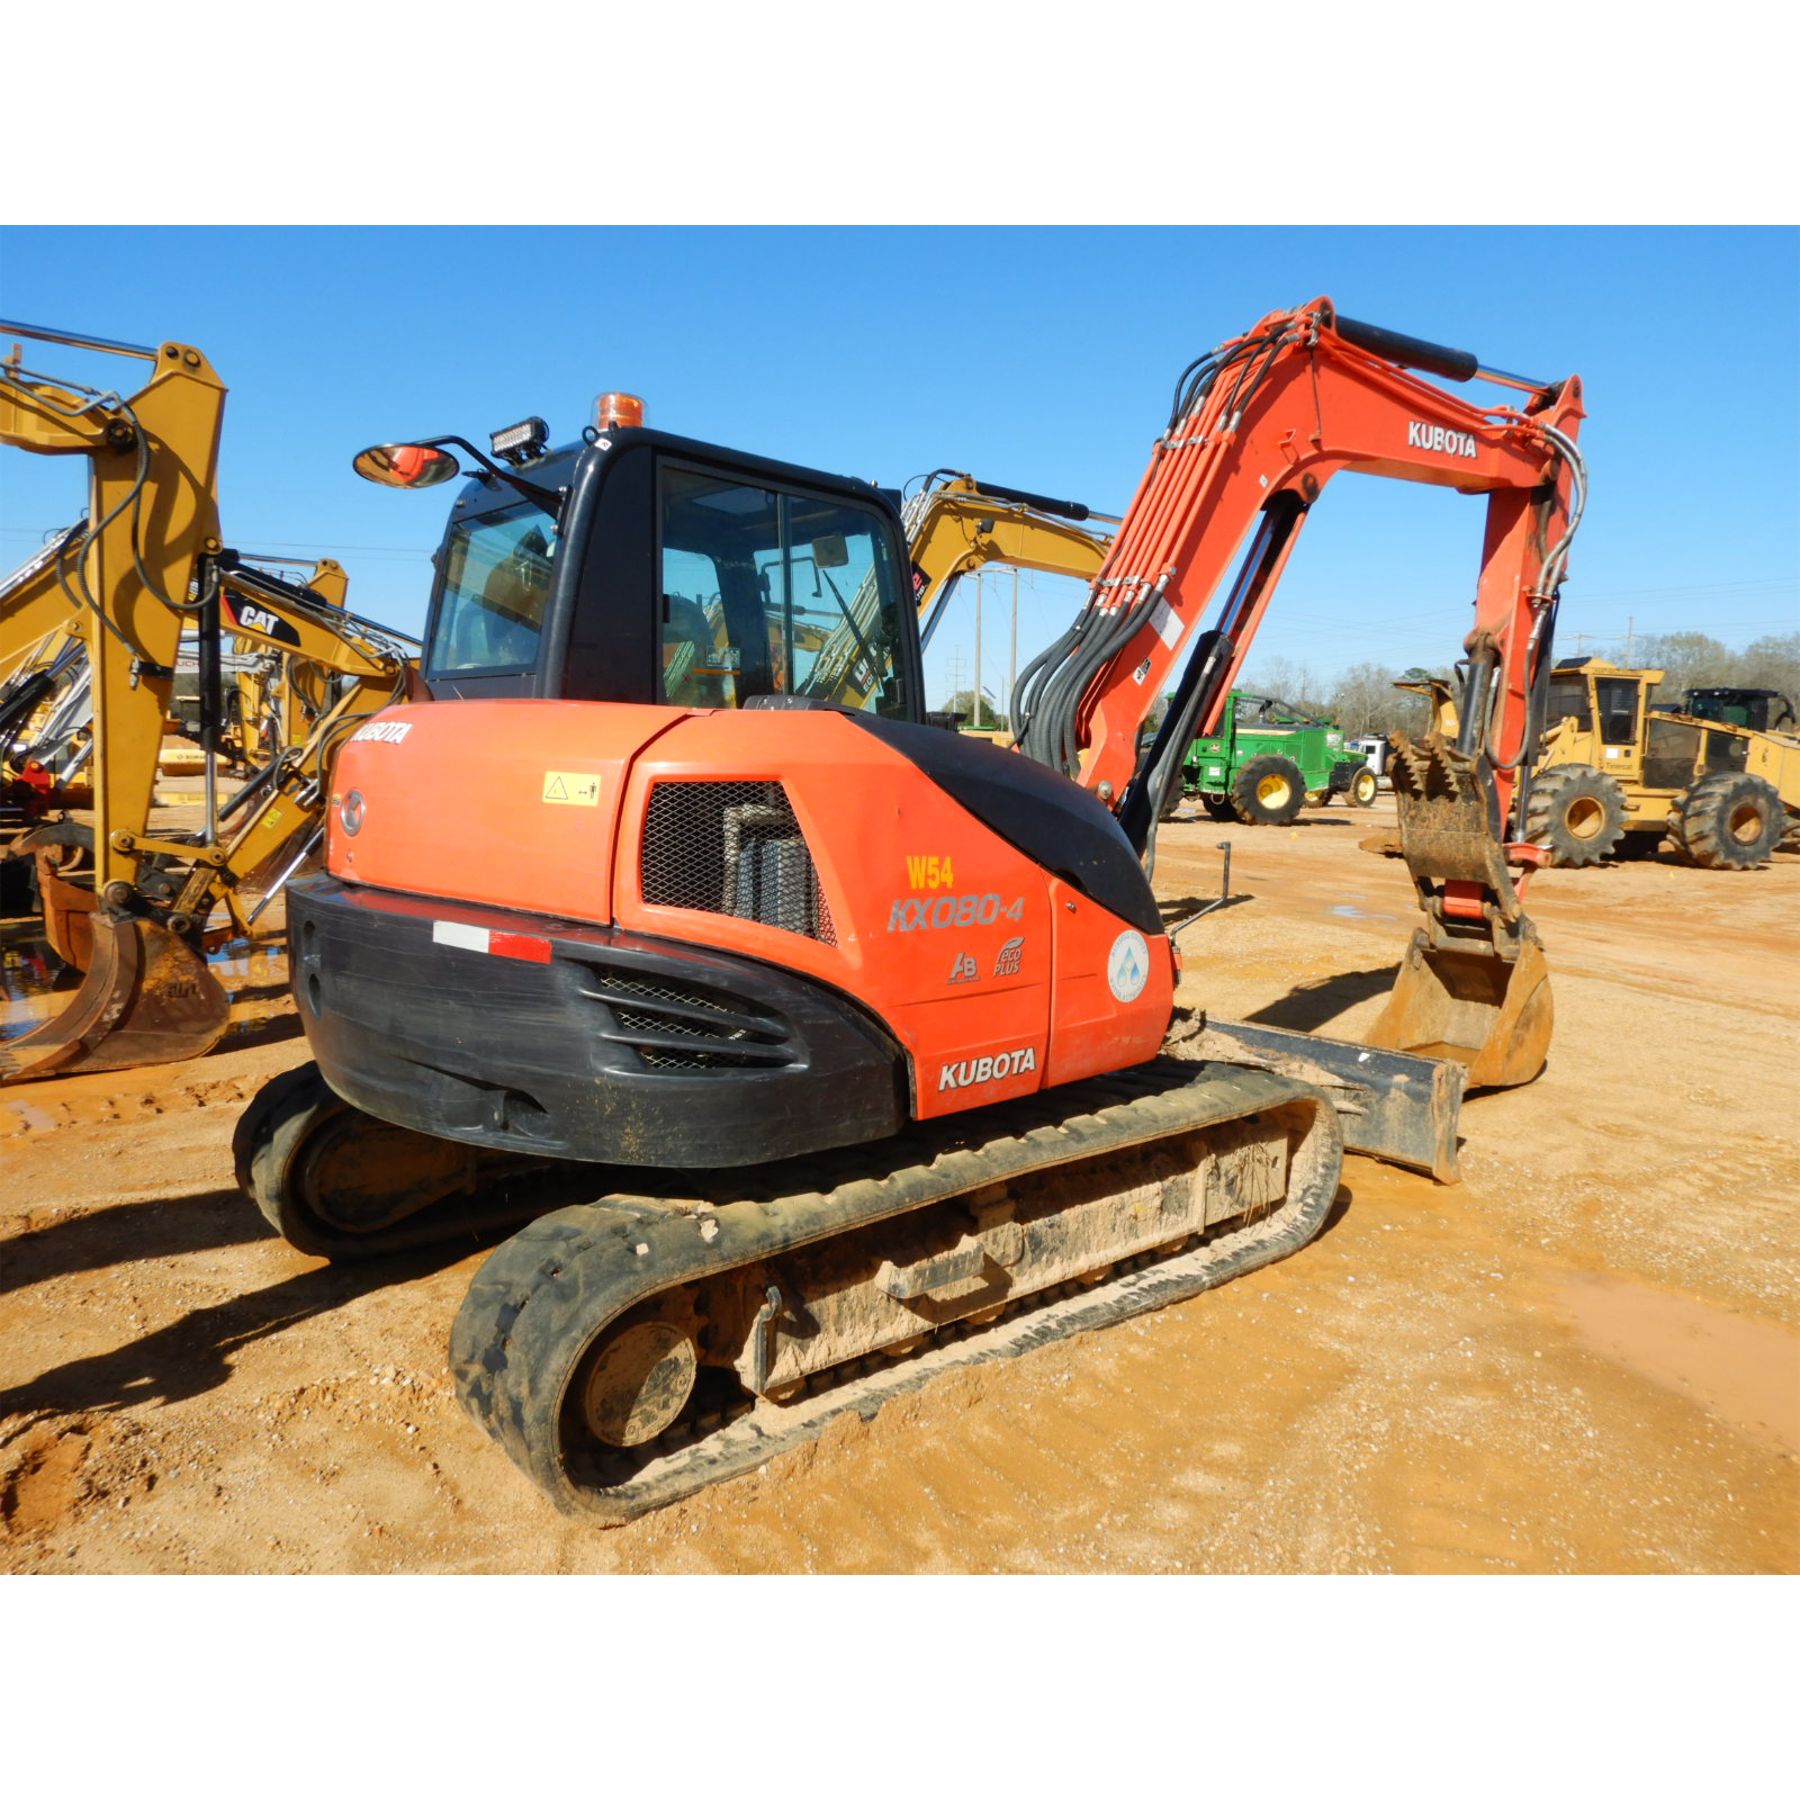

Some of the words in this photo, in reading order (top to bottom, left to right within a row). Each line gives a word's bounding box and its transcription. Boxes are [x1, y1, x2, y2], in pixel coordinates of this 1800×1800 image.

[1408, 421, 1477, 458] KUBOTA
[240, 606, 279, 635] CAT
[350, 722, 413, 744] KUBOTA
[906, 855, 954, 889] W54
[887, 893, 1025, 933] KX080-4
[993, 962, 1020, 977] PLUS
[938, 1047, 1036, 1092] KUBOTA
